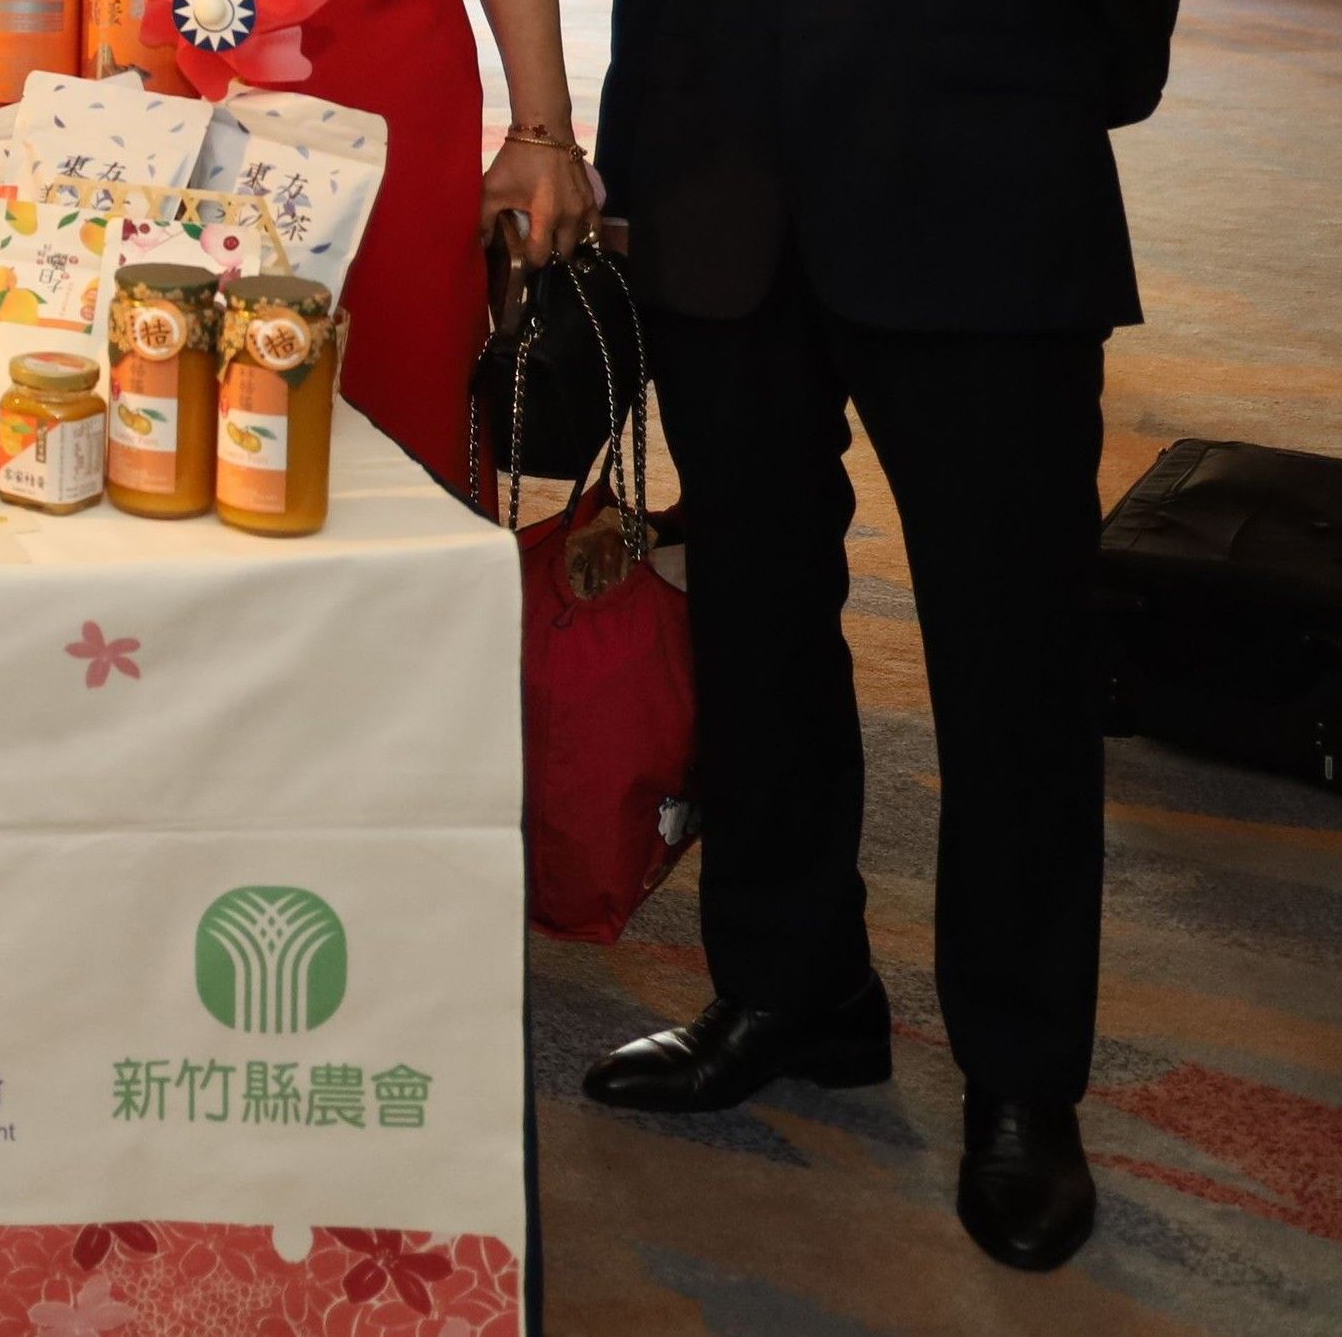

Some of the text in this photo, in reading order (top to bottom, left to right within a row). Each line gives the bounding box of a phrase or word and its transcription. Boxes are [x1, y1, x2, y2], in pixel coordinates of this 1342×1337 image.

[112, 1057, 434, 1129] 新竹縣農會
